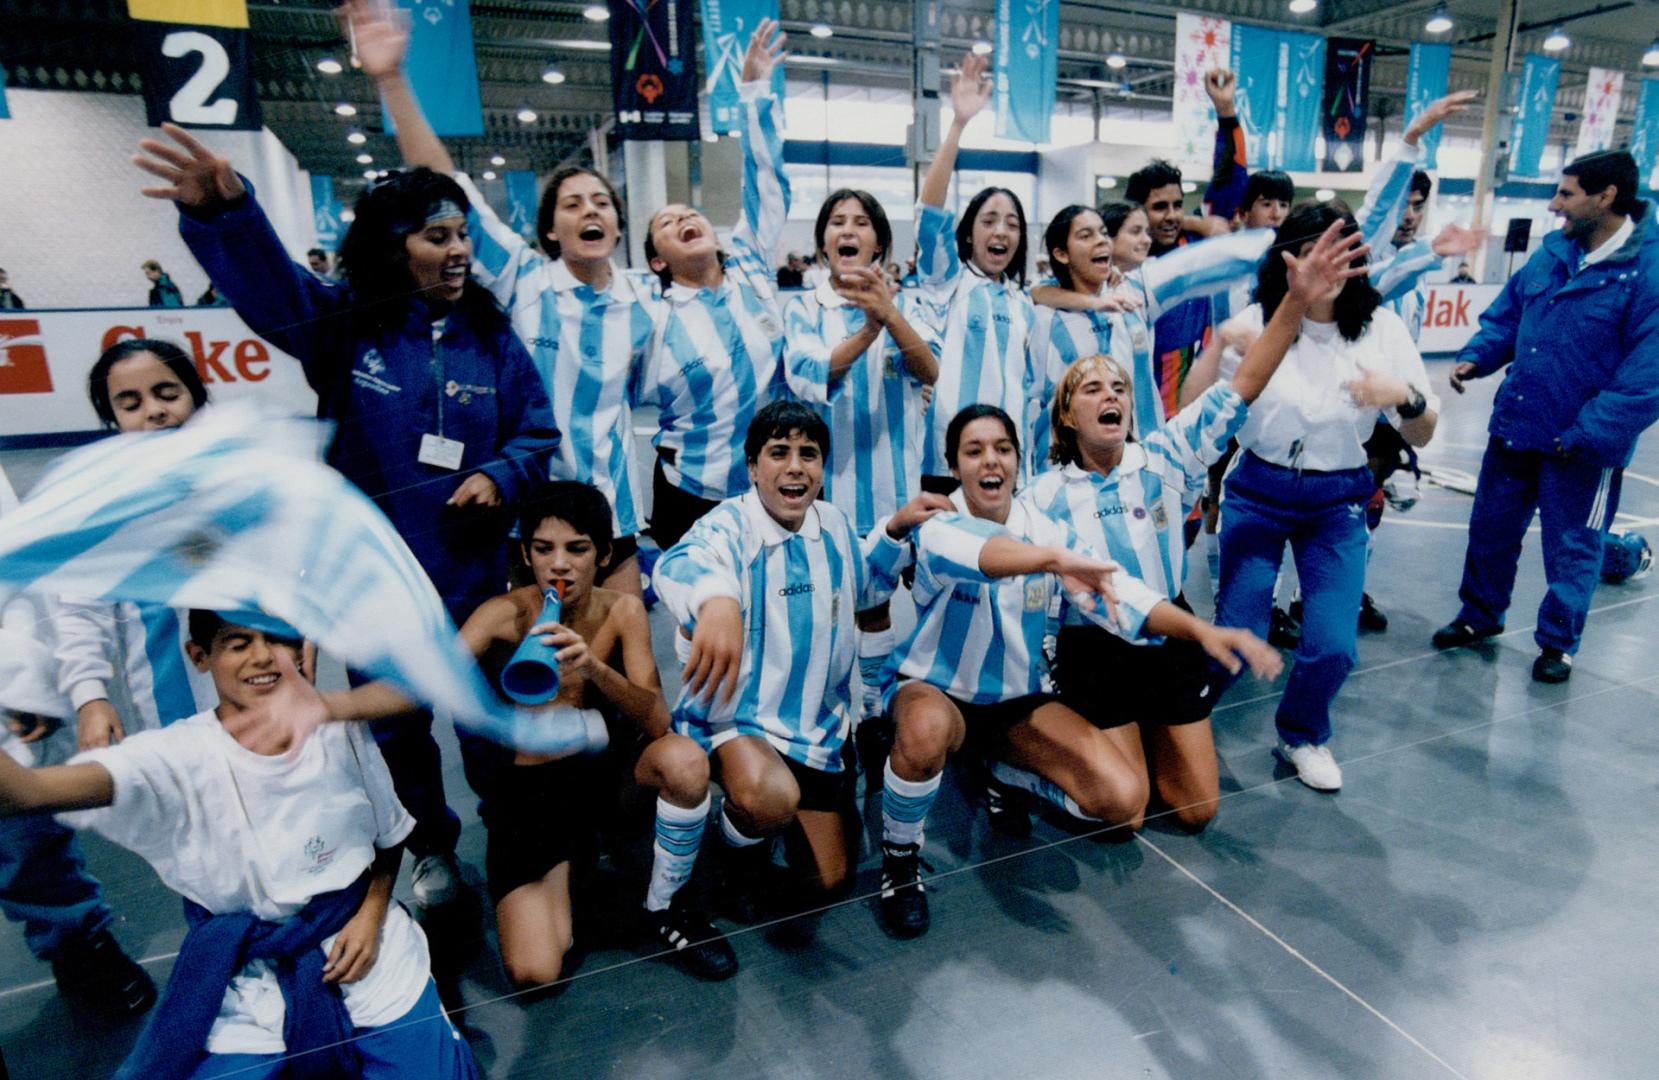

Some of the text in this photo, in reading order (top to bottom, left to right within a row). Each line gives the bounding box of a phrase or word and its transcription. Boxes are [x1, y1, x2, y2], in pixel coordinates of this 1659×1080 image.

[161, 31, 238, 125] 2
[1422, 290, 1471, 328] dak
[102, 325, 271, 384] Cke
[1093, 502, 1128, 519] adidas
[778, 582, 816, 597] adidas
